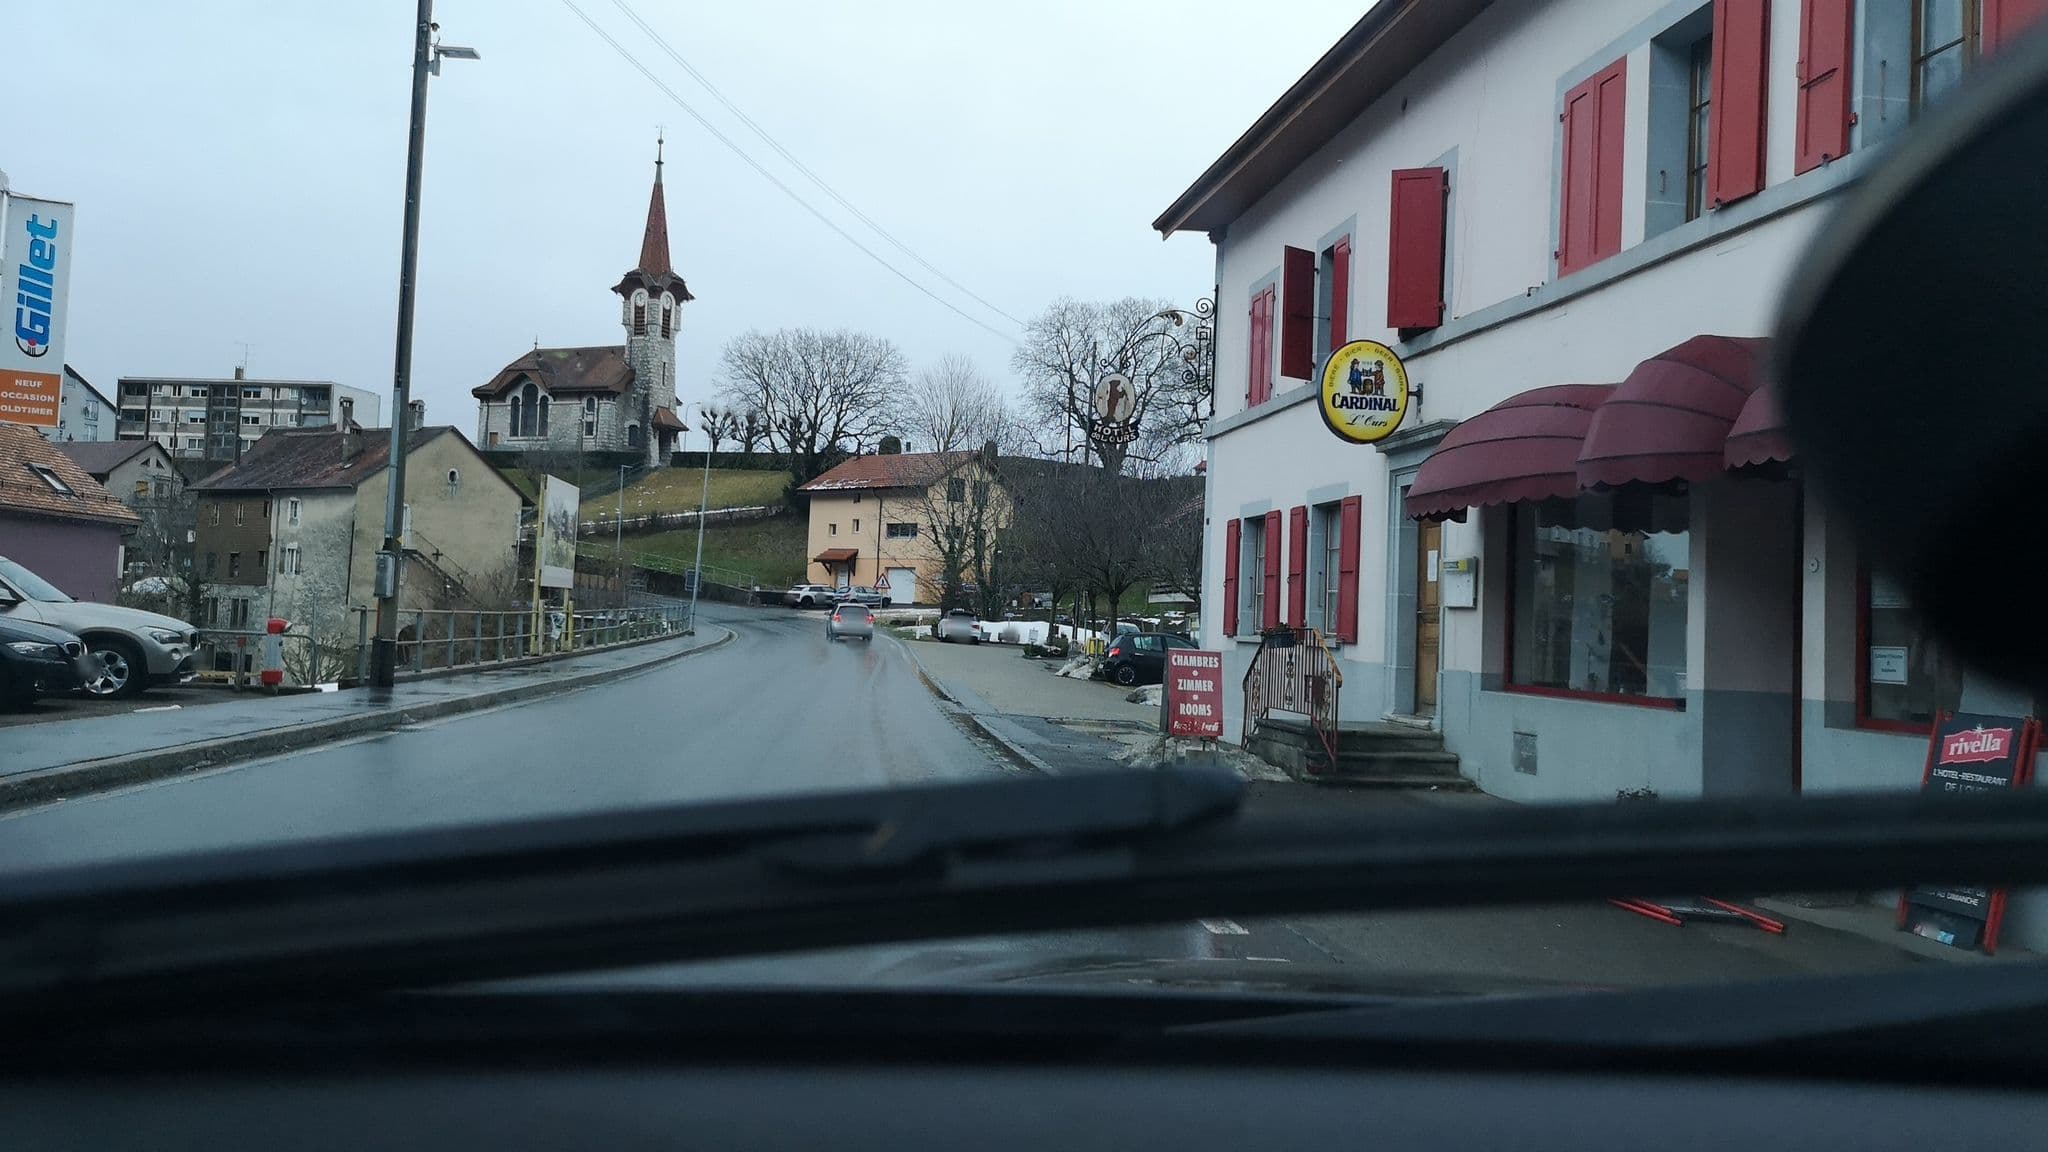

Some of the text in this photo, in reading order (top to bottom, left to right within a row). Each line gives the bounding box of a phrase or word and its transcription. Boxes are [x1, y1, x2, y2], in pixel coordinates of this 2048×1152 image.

[15, 213, 58, 346] Gillet
[15, 379, 43, 388] NEUF
[1, 391, 55, 402] OCCASION
[1332, 393, 1400, 412] CARDINAL
[0, 405, 54, 416] OLDTIMER
[1172, 654, 1219, 668] CHAMBRES
[1178, 679, 1214, 692] ZIMMER
[1180, 703, 1212, 716] ROOMS
[1949, 733, 2004, 755] rivella
